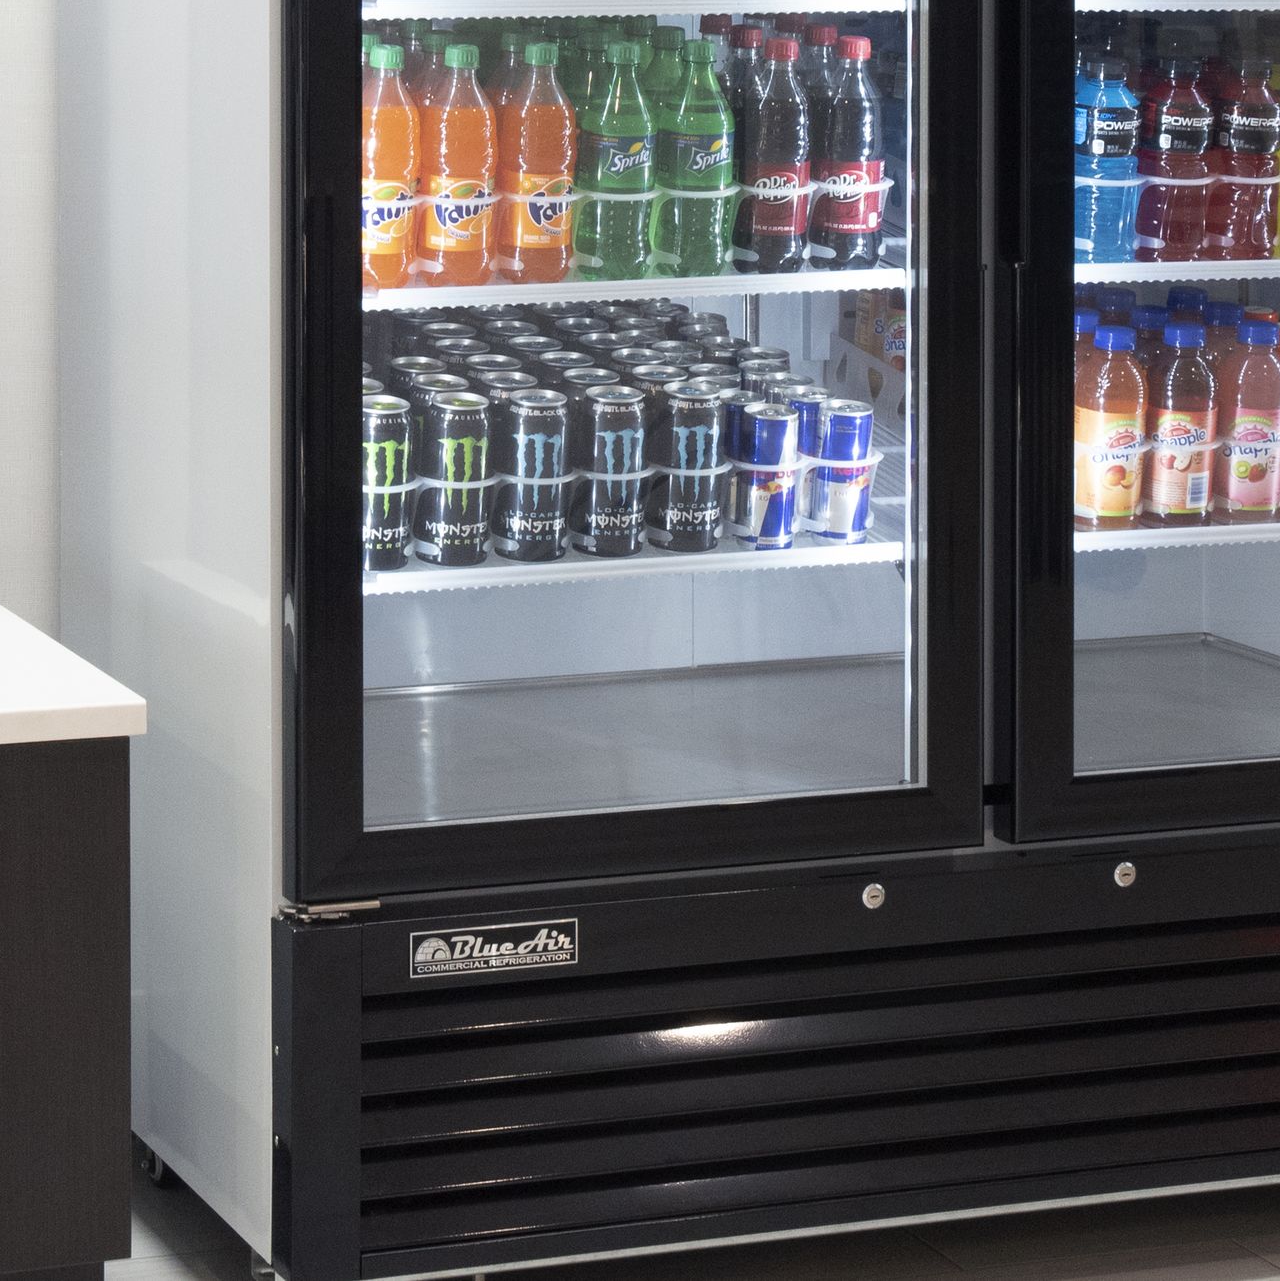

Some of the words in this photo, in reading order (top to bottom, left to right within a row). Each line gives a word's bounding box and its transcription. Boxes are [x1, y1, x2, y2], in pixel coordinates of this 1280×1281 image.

[611, 151, 650, 172] Sprite
[770, 173, 787, 188] Dr
[417, 962, 487, 973] COMMERCIAL
[489, 953, 571, 967] REFRIGERATION
